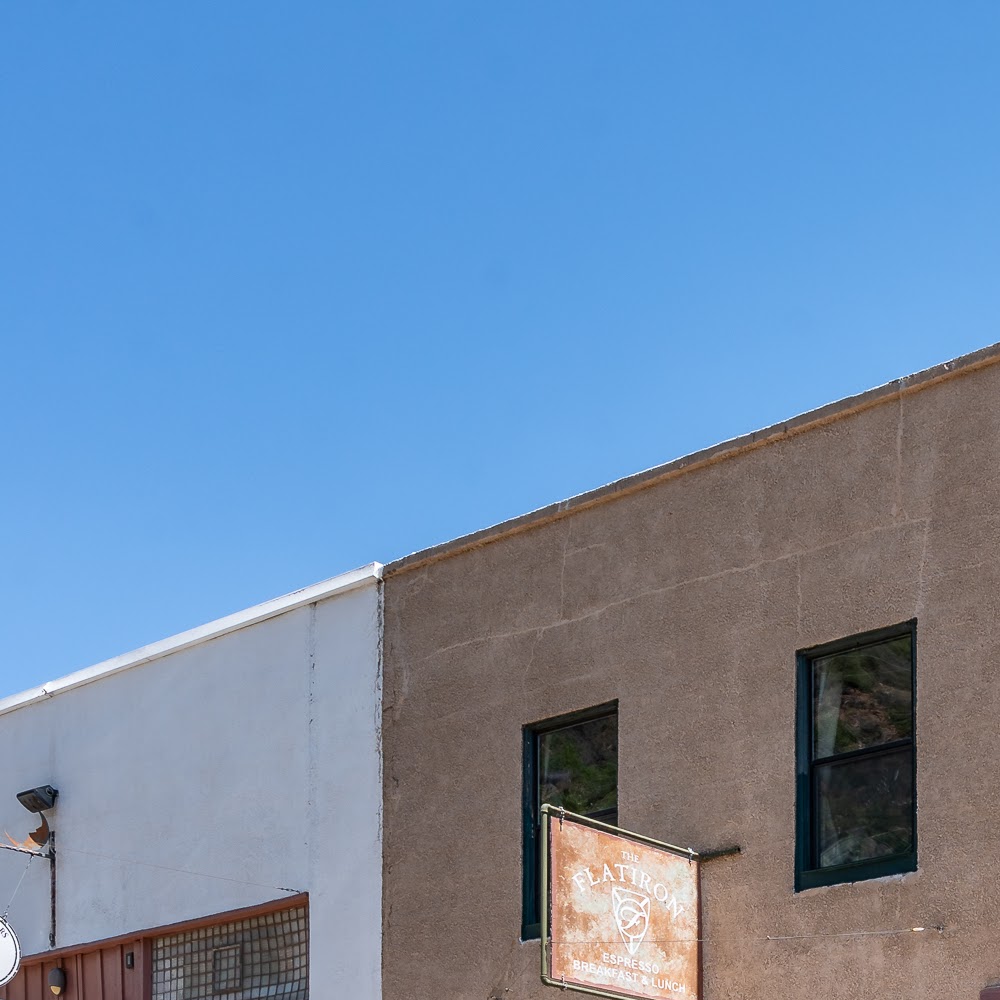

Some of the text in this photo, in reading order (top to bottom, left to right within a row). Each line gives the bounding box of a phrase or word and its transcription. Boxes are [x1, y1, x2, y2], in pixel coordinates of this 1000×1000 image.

[621, 851, 639, 863] THE
[572, 863, 684, 919] FLATIRON
[573, 959, 686, 993] BREAKFAST & LUNCH
[603, 953, 660, 974] ESPRESSO
